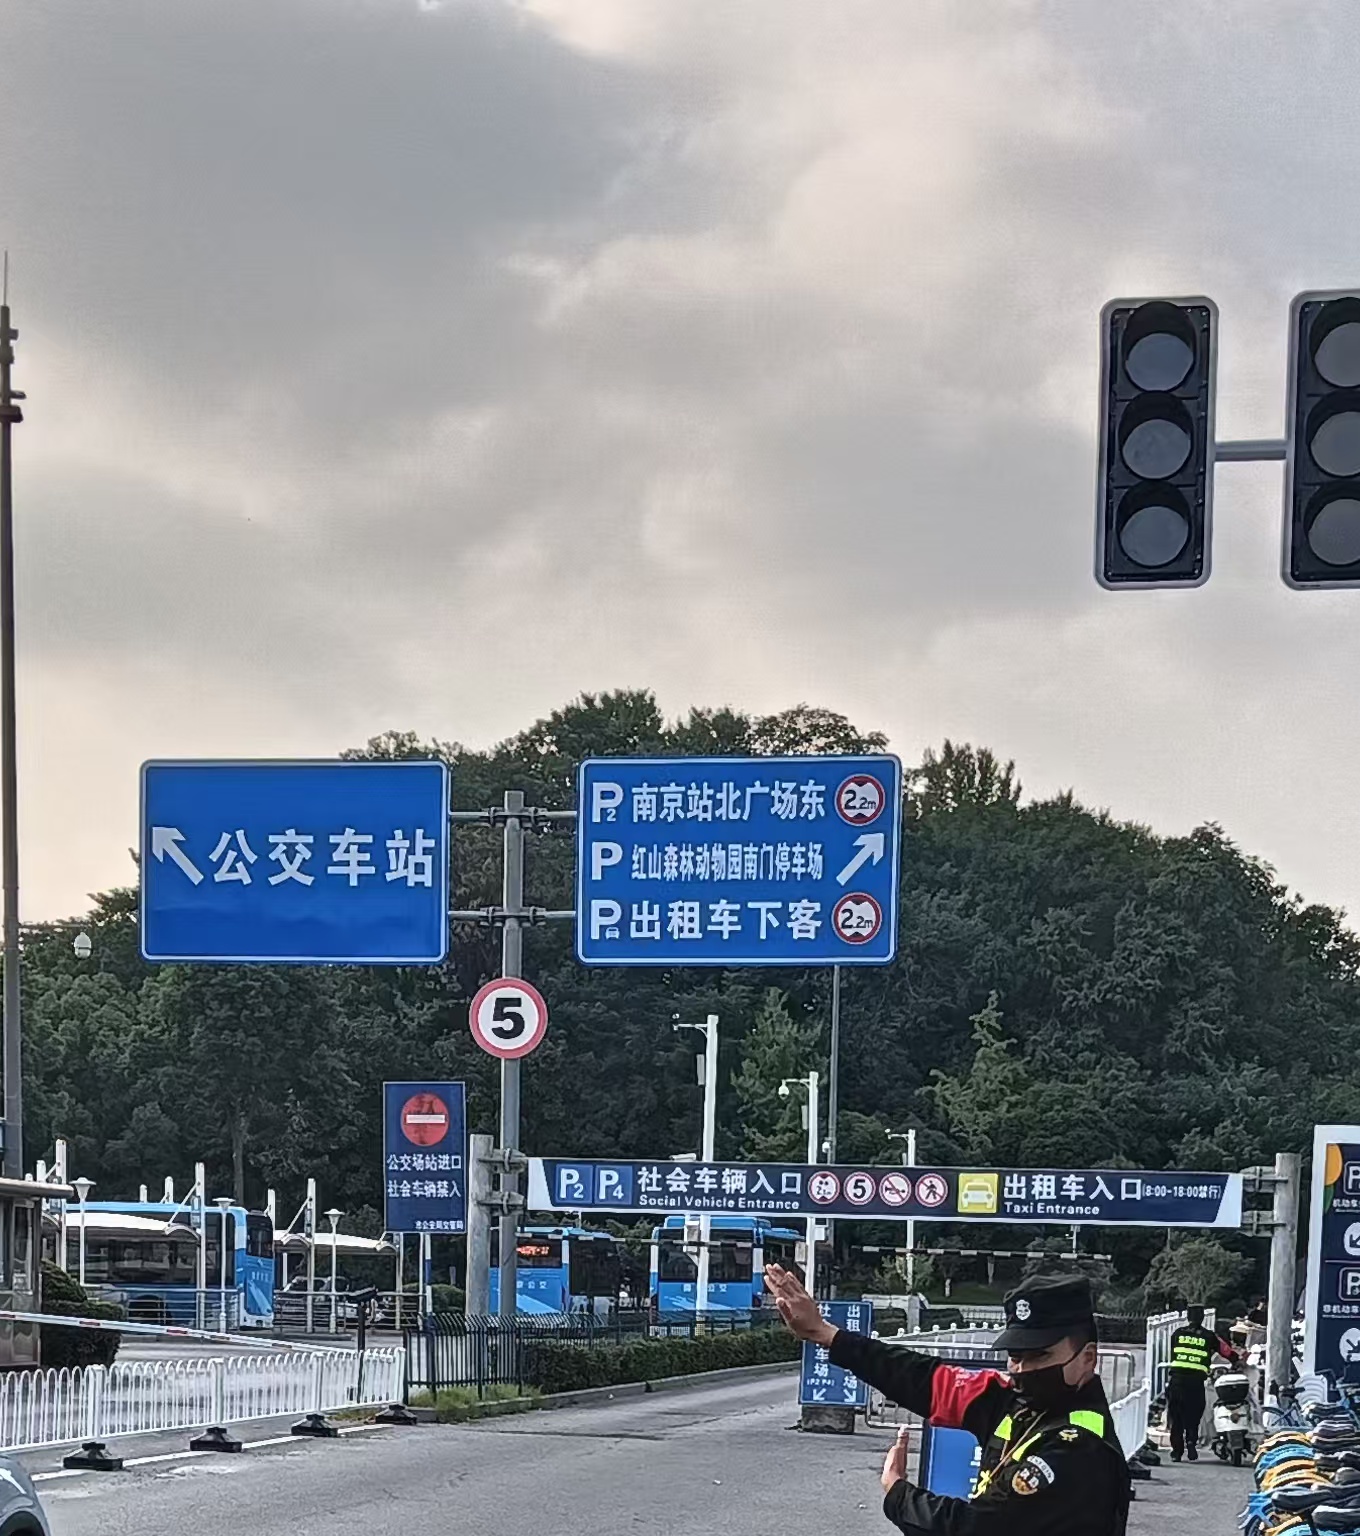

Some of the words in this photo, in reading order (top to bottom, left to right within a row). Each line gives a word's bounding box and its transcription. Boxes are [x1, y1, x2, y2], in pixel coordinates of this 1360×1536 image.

[631, 780, 826, 823] 南京站北广场东
[209, 828, 436, 887] 公交车站
[591, 842, 623, 881] P
[631, 841, 823, 882] 红山森林动物园南门停车场
[630, 898, 822, 940] 出租车下客
[491, 997, 526, 1039] 5
[386, 1154, 462, 1172] 公交场站进口
[387, 1180, 462, 1198] 社会车辆禁入
[560, 1168, 584, 1199] P2
[598, 1170, 624, 1200] P4
[638, 1166, 802, 1195] 社会车辆入口
[852, 1178, 867, 1198] 5
[1004, 1173, 1141, 1200] 出租车入口
[639, 1195, 681, 1207] Social
[685, 1196, 734, 1208] Vehicle
[738, 1197, 800, 1210] Entrance
[1004, 1202, 1034, 1214] Taxi
[1037, 1202, 1100, 1215] Entrance
